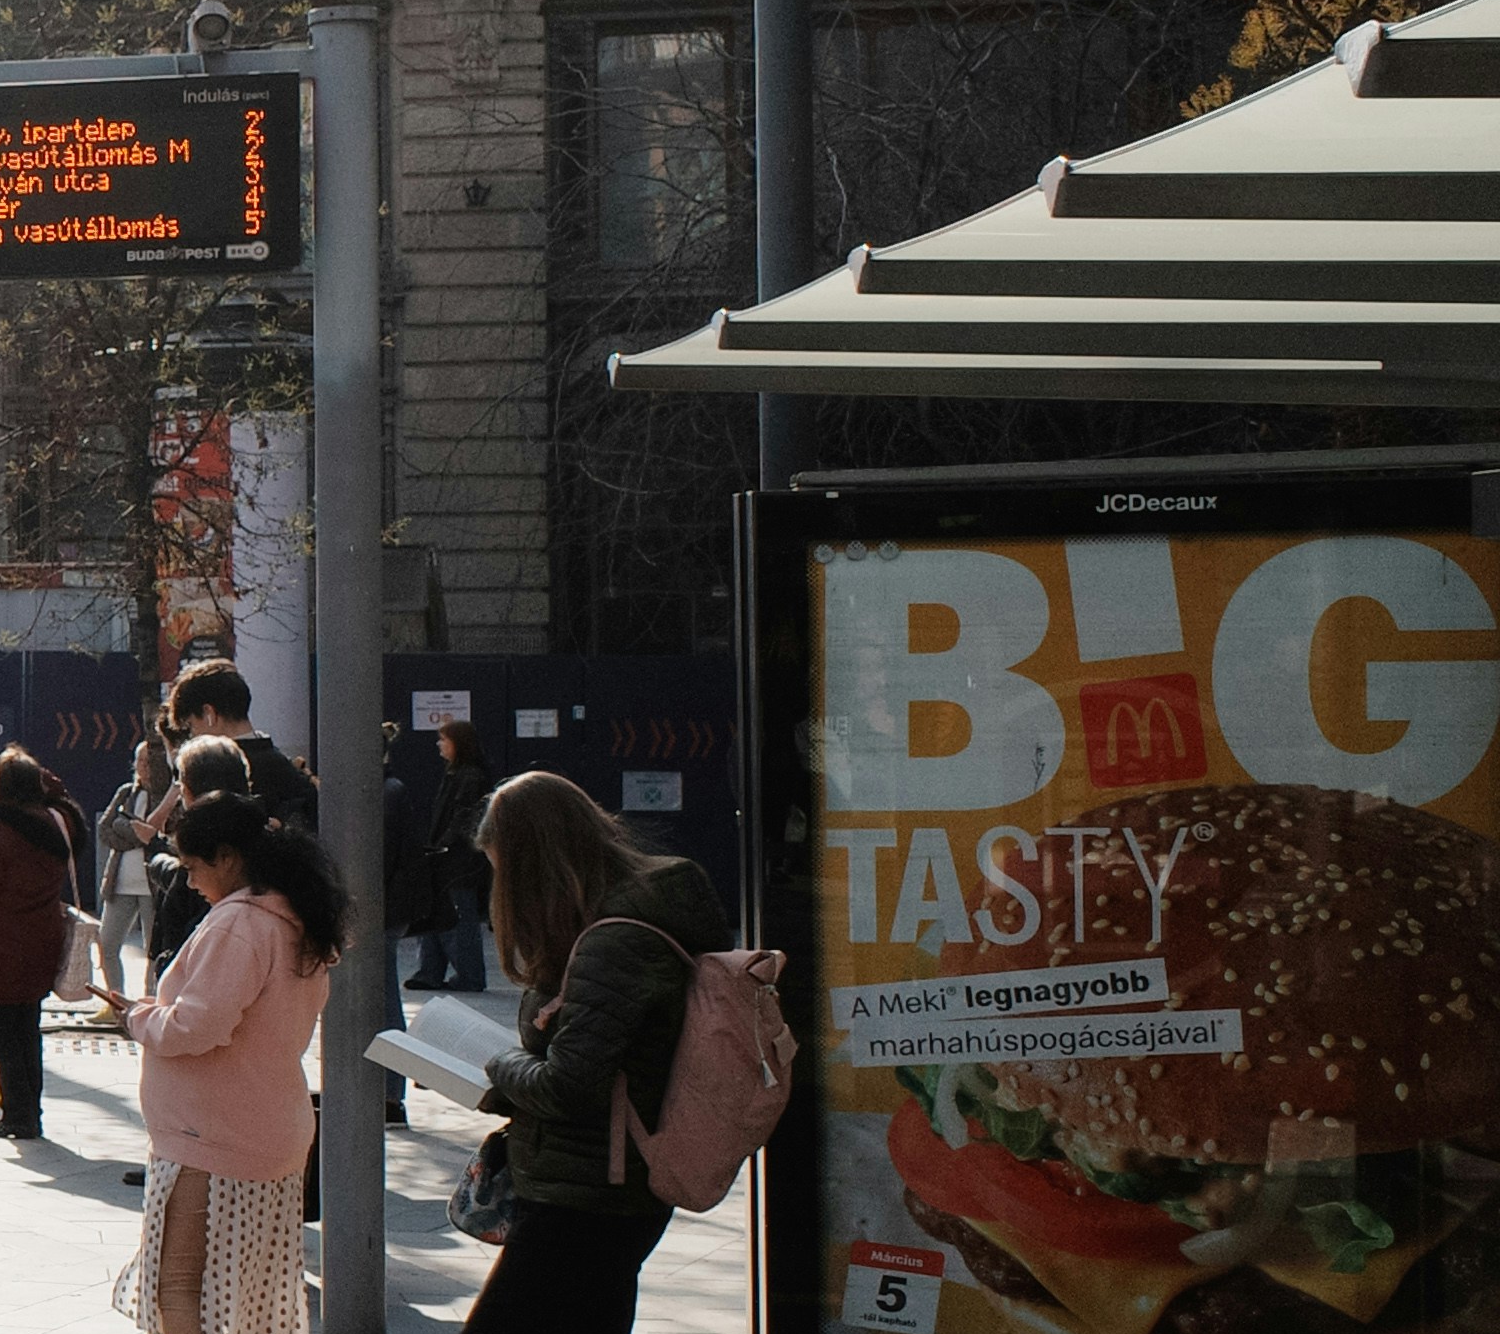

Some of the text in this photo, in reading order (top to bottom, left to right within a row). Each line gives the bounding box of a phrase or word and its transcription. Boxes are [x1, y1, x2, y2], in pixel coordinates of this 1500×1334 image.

[182, 88, 240, 103] Indulás
[22, 118, 136, 145] ipartelep
[169, 138, 190, 164] M
[54, 168, 110, 193] utca
[14, 213, 180, 244] vasútállomás
[1095, 493, 1218, 513] JCDecaux
[824, 534, 1500, 813] BIG
[851, 996, 871, 1019] A
[965, 969, 1150, 1012] legnagyobb
[870, 1250, 924, 1268] Március
[875, 1274, 908, 1313] 5
[877, 1314, 917, 1328] kapható
